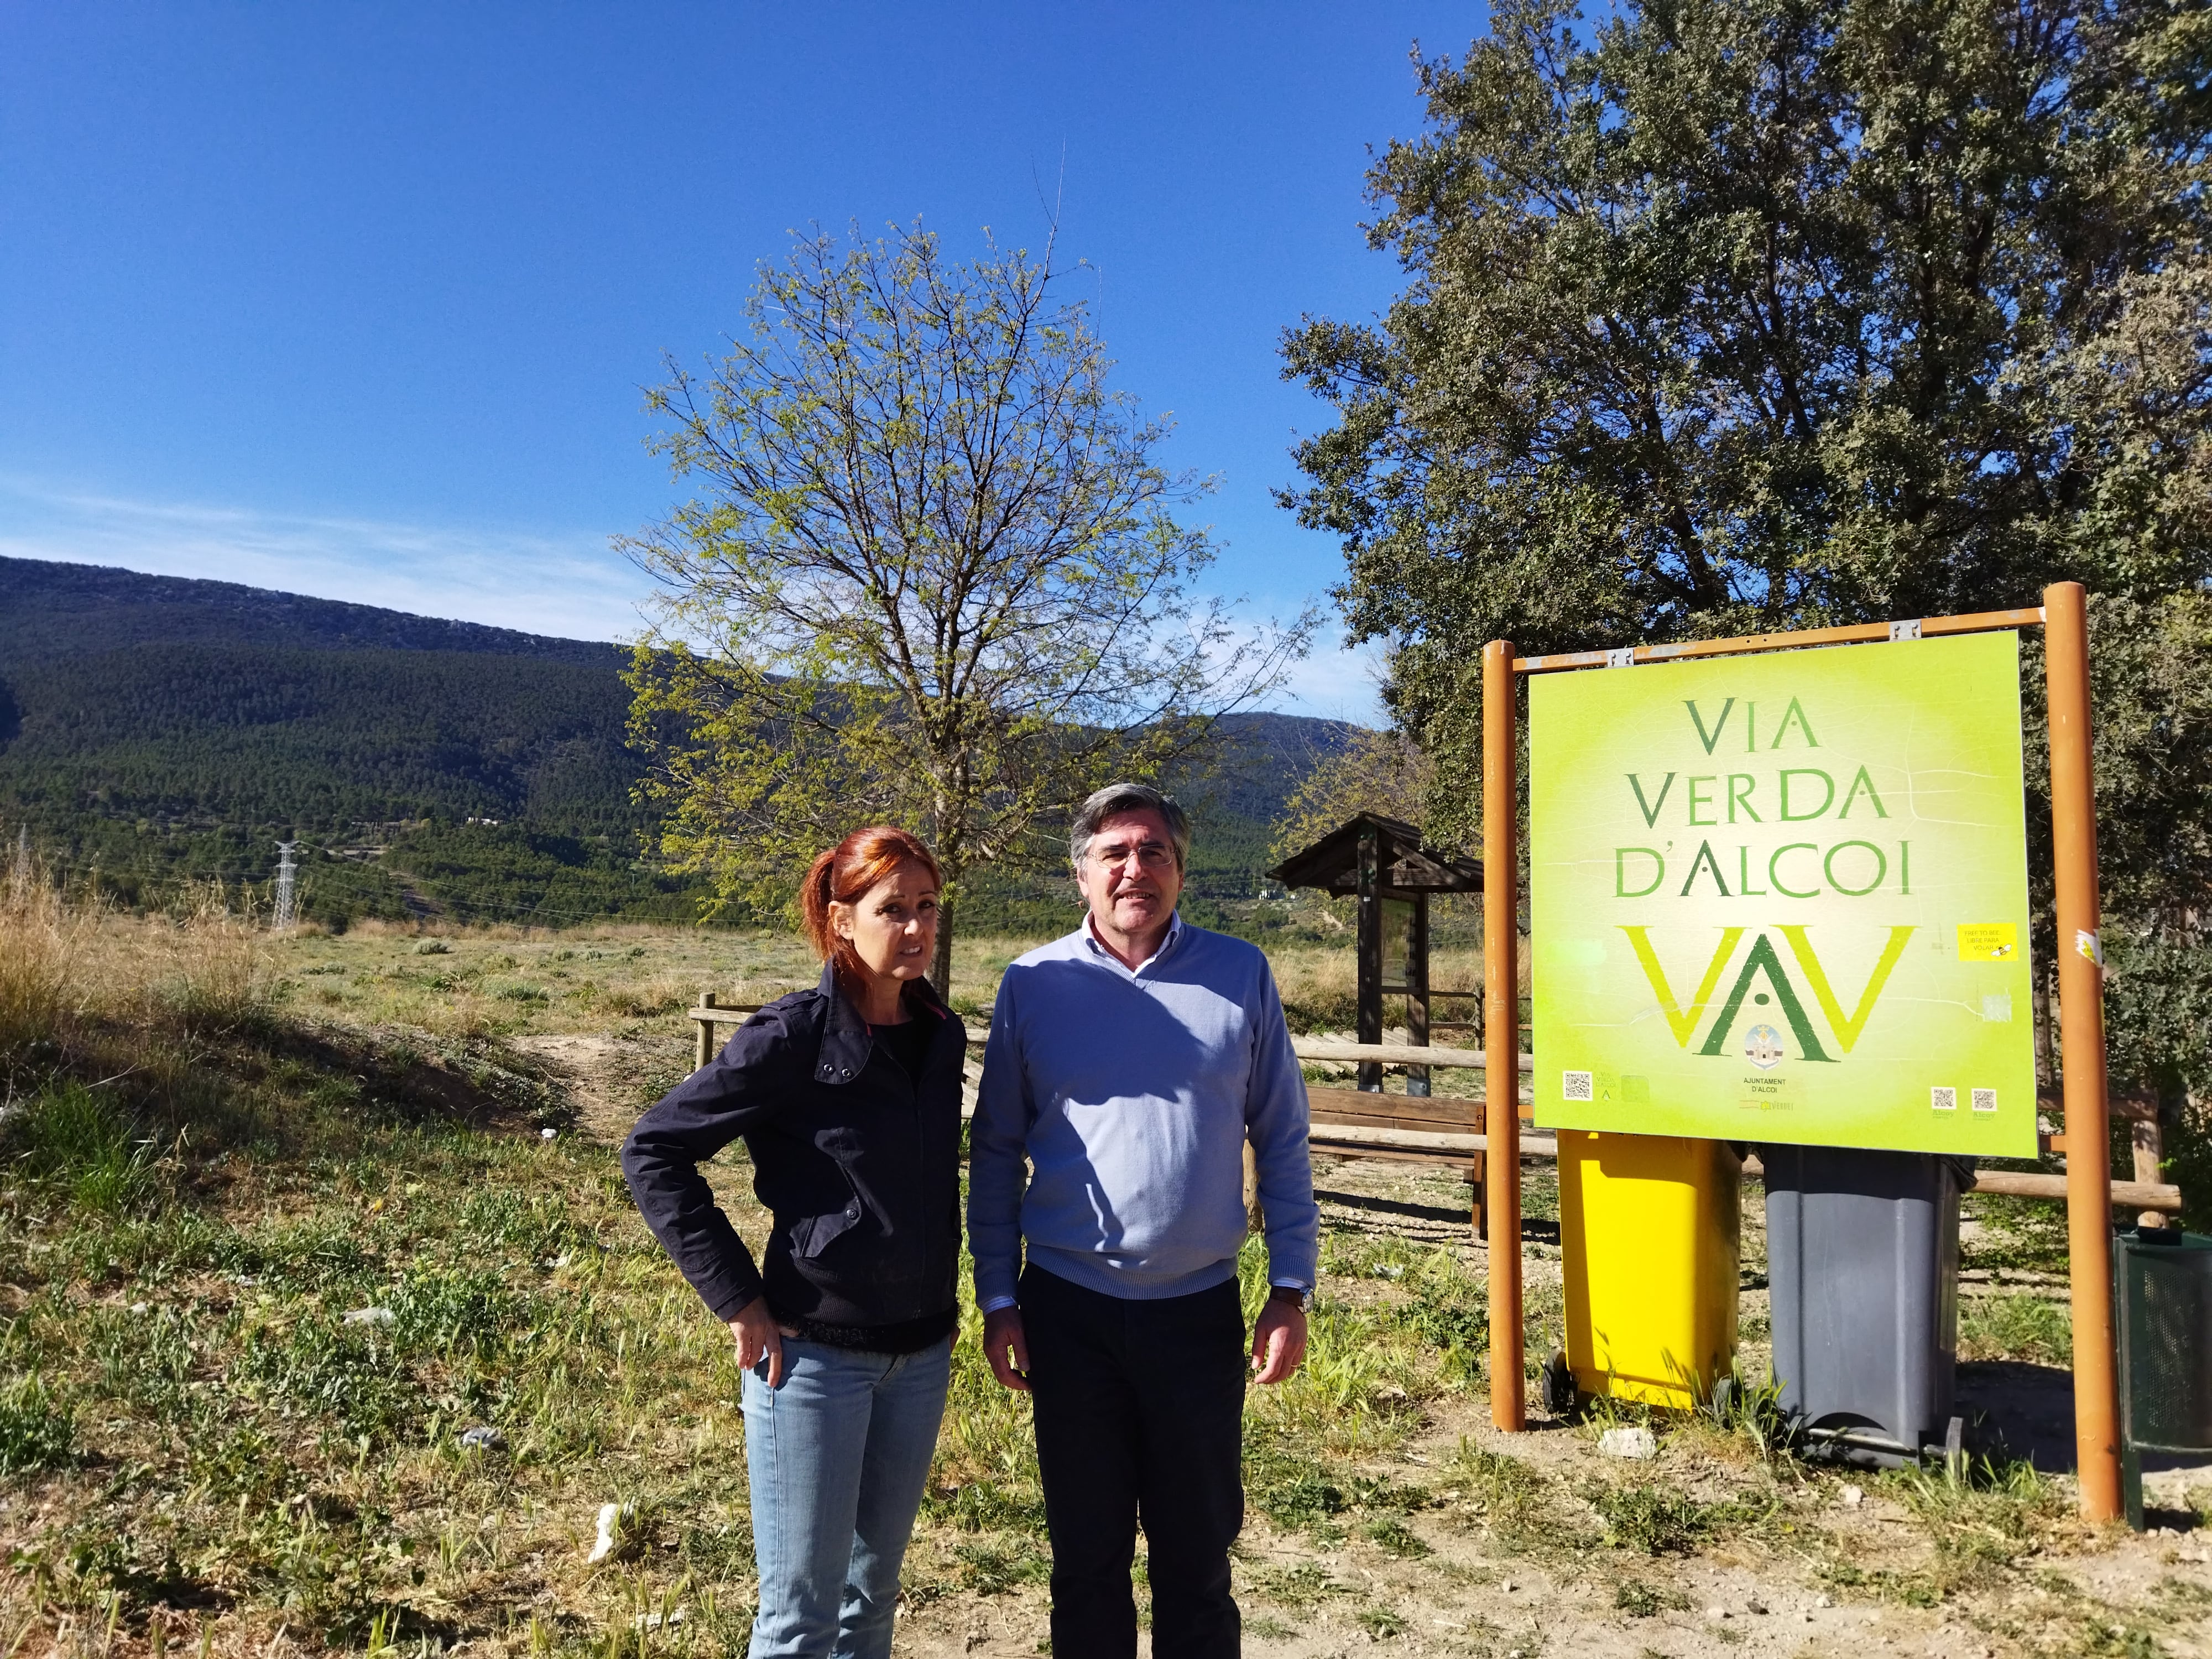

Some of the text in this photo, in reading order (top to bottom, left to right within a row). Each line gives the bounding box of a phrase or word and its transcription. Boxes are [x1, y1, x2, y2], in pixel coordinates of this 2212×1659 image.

[1681, 695, 1823, 756] VIA
[1623, 764, 1892, 829] VERDA
[1611, 839, 1915, 899] D'ALCOI
